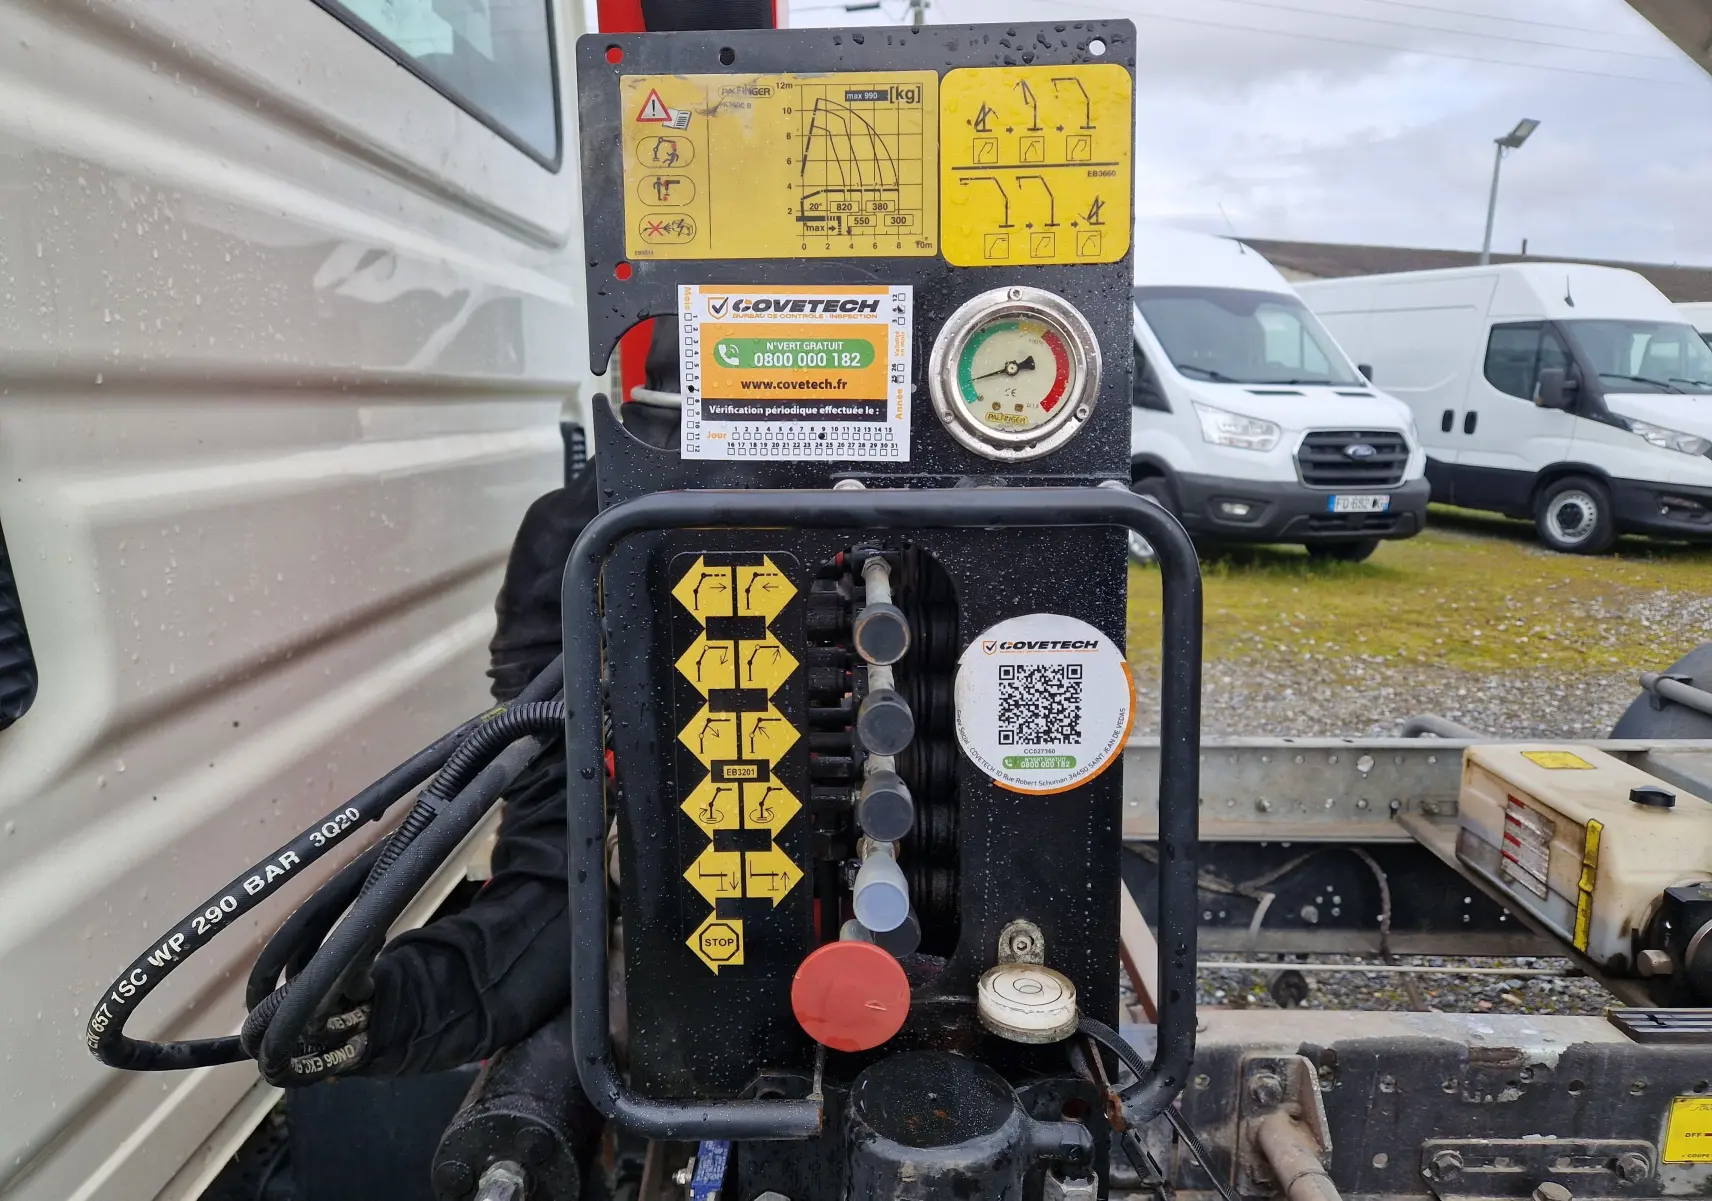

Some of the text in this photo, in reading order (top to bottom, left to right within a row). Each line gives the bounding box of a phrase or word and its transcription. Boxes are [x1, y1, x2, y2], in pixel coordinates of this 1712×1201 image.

[776, 81, 793, 89] 12m
[889, 86, 921, 104] [kg]
[787, 207, 792, 215] 2
[836, 203, 852, 211] 820
[854, 217, 870, 225] 550
[890, 216, 907, 224] 300
[896, 241, 901, 249] 8
[892, 294, 898, 302] 12
[732, 299, 880, 313] COVETECH
[766, 342, 844, 350] N°VERT GRATUIT
[754, 352, 861, 367] 0800 000 182
[892, 363, 897, 372] 26
[741, 379, 848, 390] www.covetech.fr
[709, 405, 762, 415] Vérification
[765, 405, 817, 417] périodique
[819, 404, 864, 415] effectuée
[865, 405, 874, 415] le
[695, 421, 700, 429] 10
[707, 431, 727, 439] Jour
[695, 445, 700, 453] 12
[1000, 640, 1099, 650] COVETECH
[970, 747, 995, 772] COVETECH
[1003, 773, 1015, 782] Rue
[1015, 777, 1037, 786] Robert
[1038, 778, 1068, 786] Schuman
[1068, 766, 1089, 780] 34450
[1088, 752, 1105, 769] SAINT
[1104, 738, 1115, 754] JEAN
[1112, 730, 1120, 740] DE
[1116, 707, 1126, 729] VEDAS
[726, 768, 755, 776] EB3201
[91, 1003, 113, 1033] 857
[111, 968, 148, 1004] 1SC
[147, 932, 185, 969] WP
[191, 895, 238, 935] 290
[243, 850, 300, 896] BAR
[308, 807, 360, 848] 3Q20
[704, 938, 734, 947] STOP
